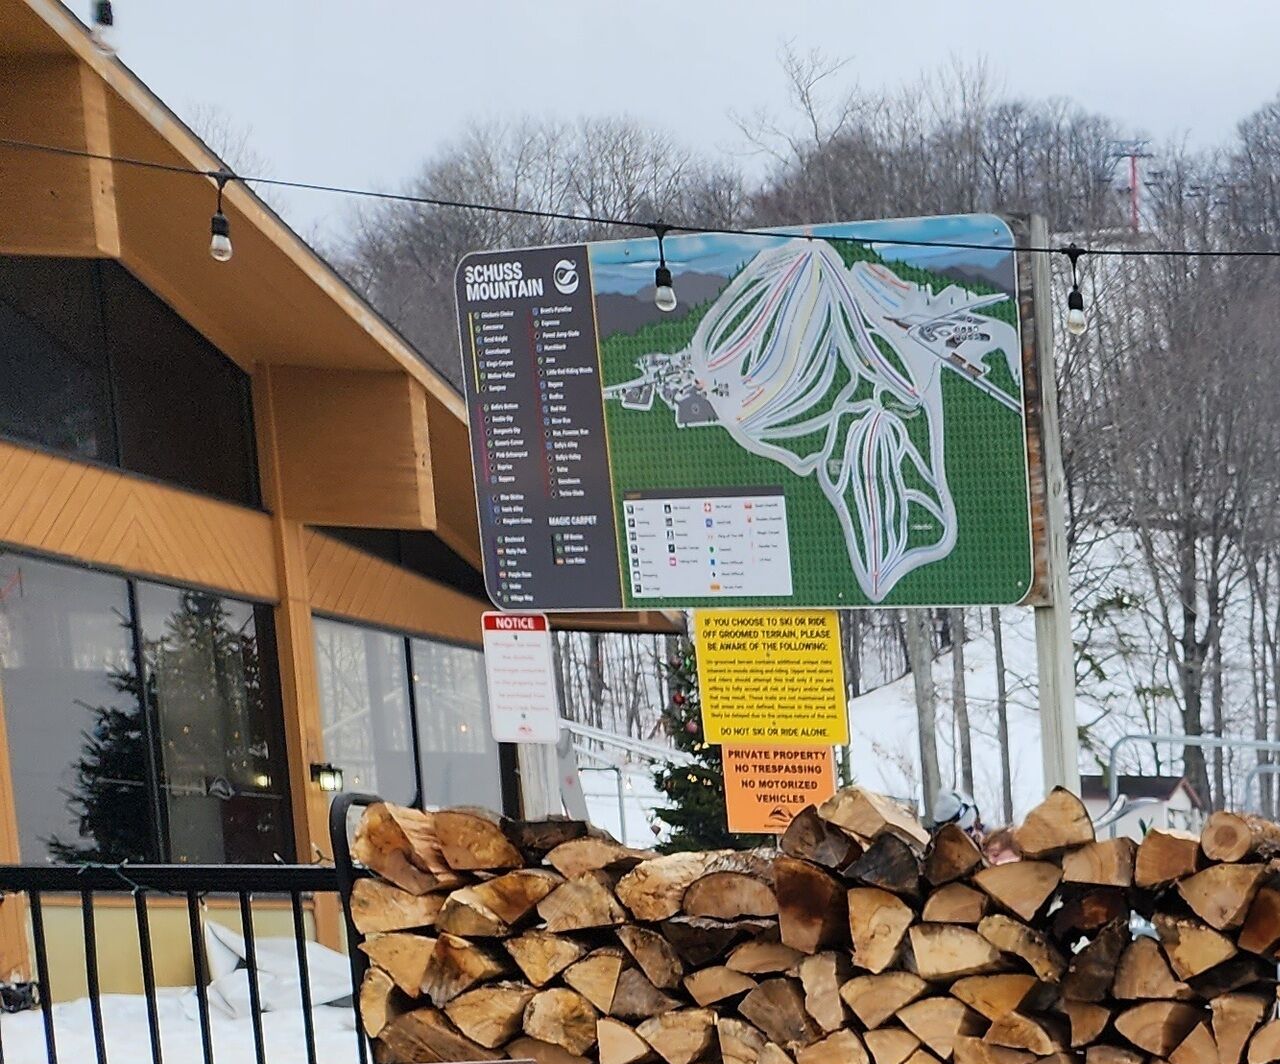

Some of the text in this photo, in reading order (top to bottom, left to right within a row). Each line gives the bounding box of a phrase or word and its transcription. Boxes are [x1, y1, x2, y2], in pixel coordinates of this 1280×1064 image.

[465, 262, 523, 283] SCHUSS
[466, 278, 544, 301] MOUNTAIN
[548, 515, 598, 526] MAGIC CARPET
[495, 617, 535, 629] NOTICE
[704, 616, 826, 626] IF YOU CHOOSE TO SKI OR RIDE
[702, 630, 831, 640] OFF GROOMED TERRAIN, PLEASE
[707, 642, 717, 651] BE
[719, 642, 747, 651] AWARE
[749, 642, 759, 651] OF
[762, 642, 777, 651] THE
[720, 727, 732, 736] DO
[733, 727, 750, 736] NOT
[752, 727, 765, 736] SKI
[767, 727, 779, 736] OR
[780, 727, 798, 737] RIDE
[728, 750, 827, 760] PRIVATE PROPERTY
[735, 764, 822, 774] NO TRESPASSING
[741, 780, 818, 789] NO MOTORIZED
[756, 795, 805, 803] VEHICLES
